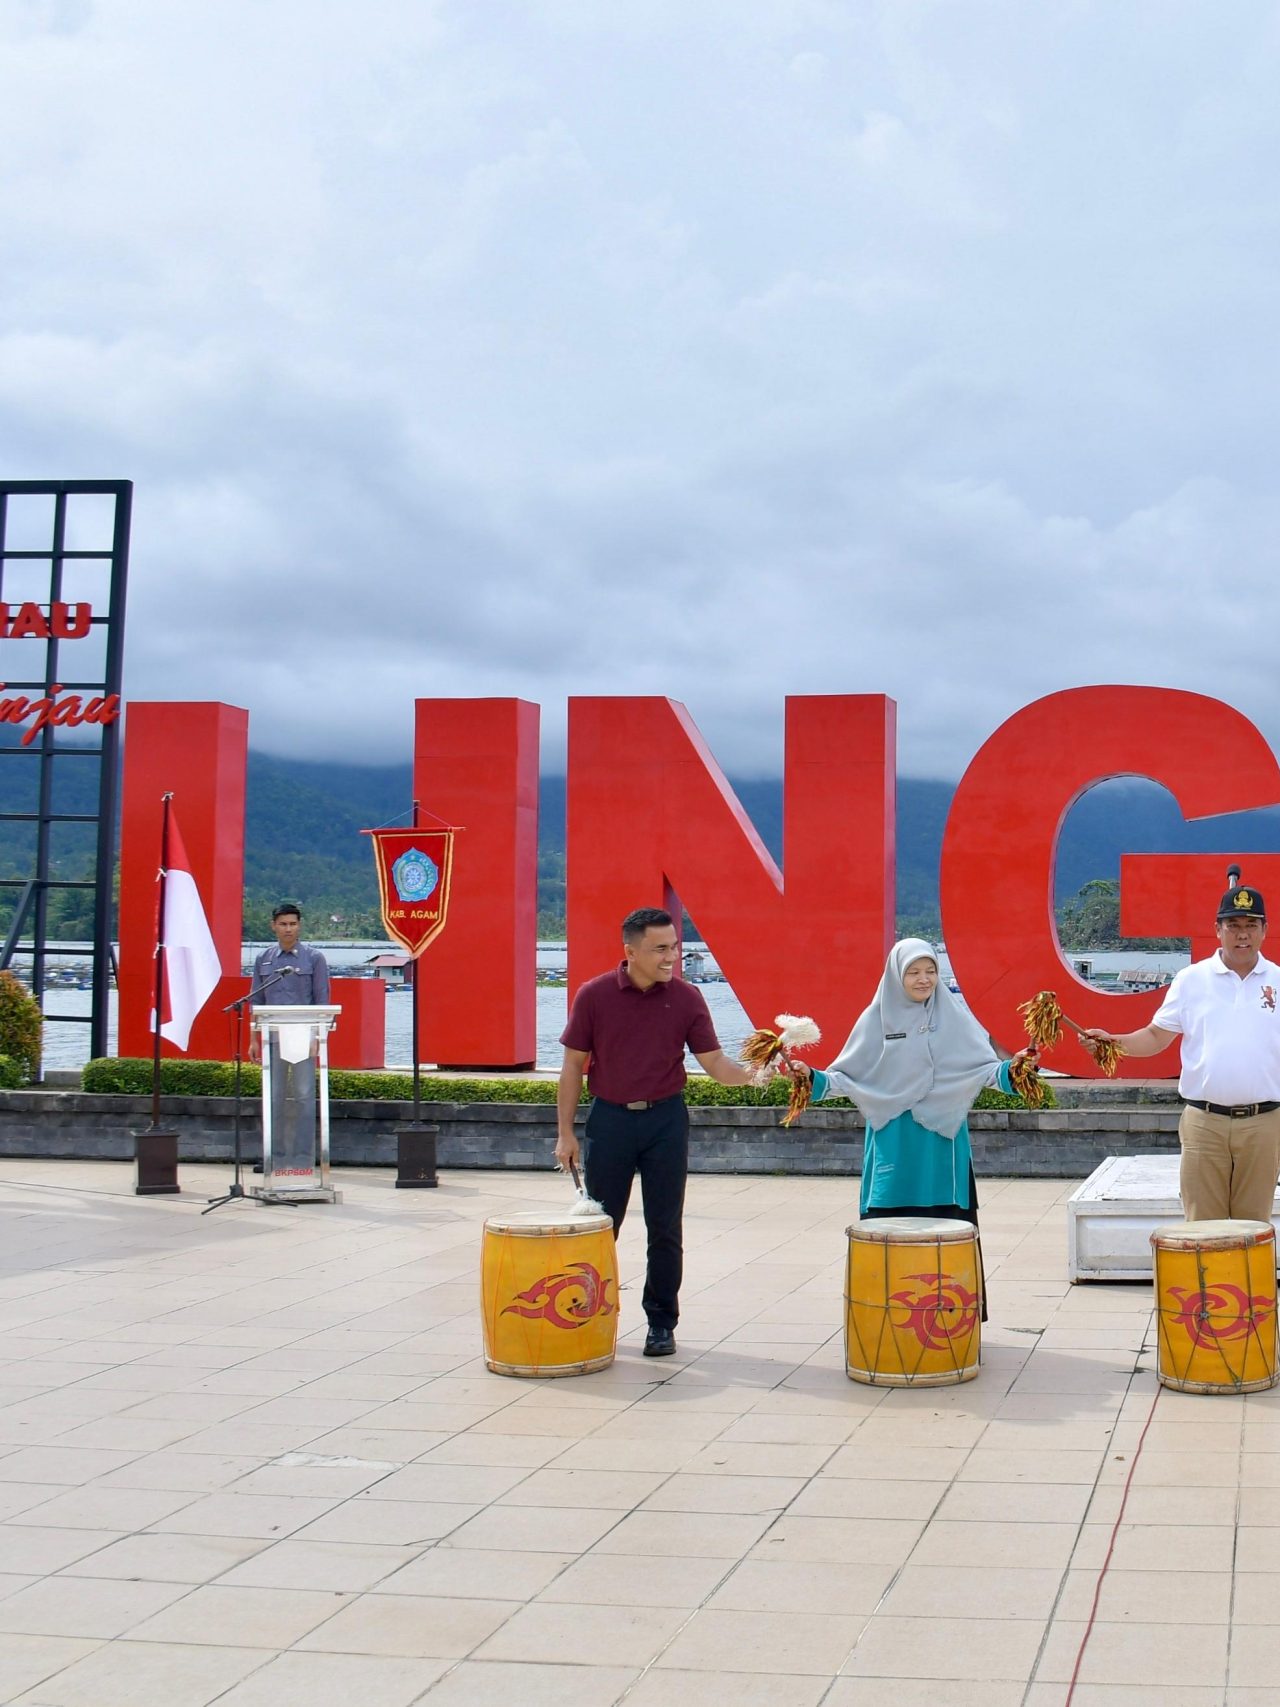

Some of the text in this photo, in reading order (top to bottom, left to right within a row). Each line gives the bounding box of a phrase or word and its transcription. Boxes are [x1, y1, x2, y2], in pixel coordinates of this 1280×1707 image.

[0, 601, 92, 639] AU
[390, 910, 439, 920] KAB. AGAM
